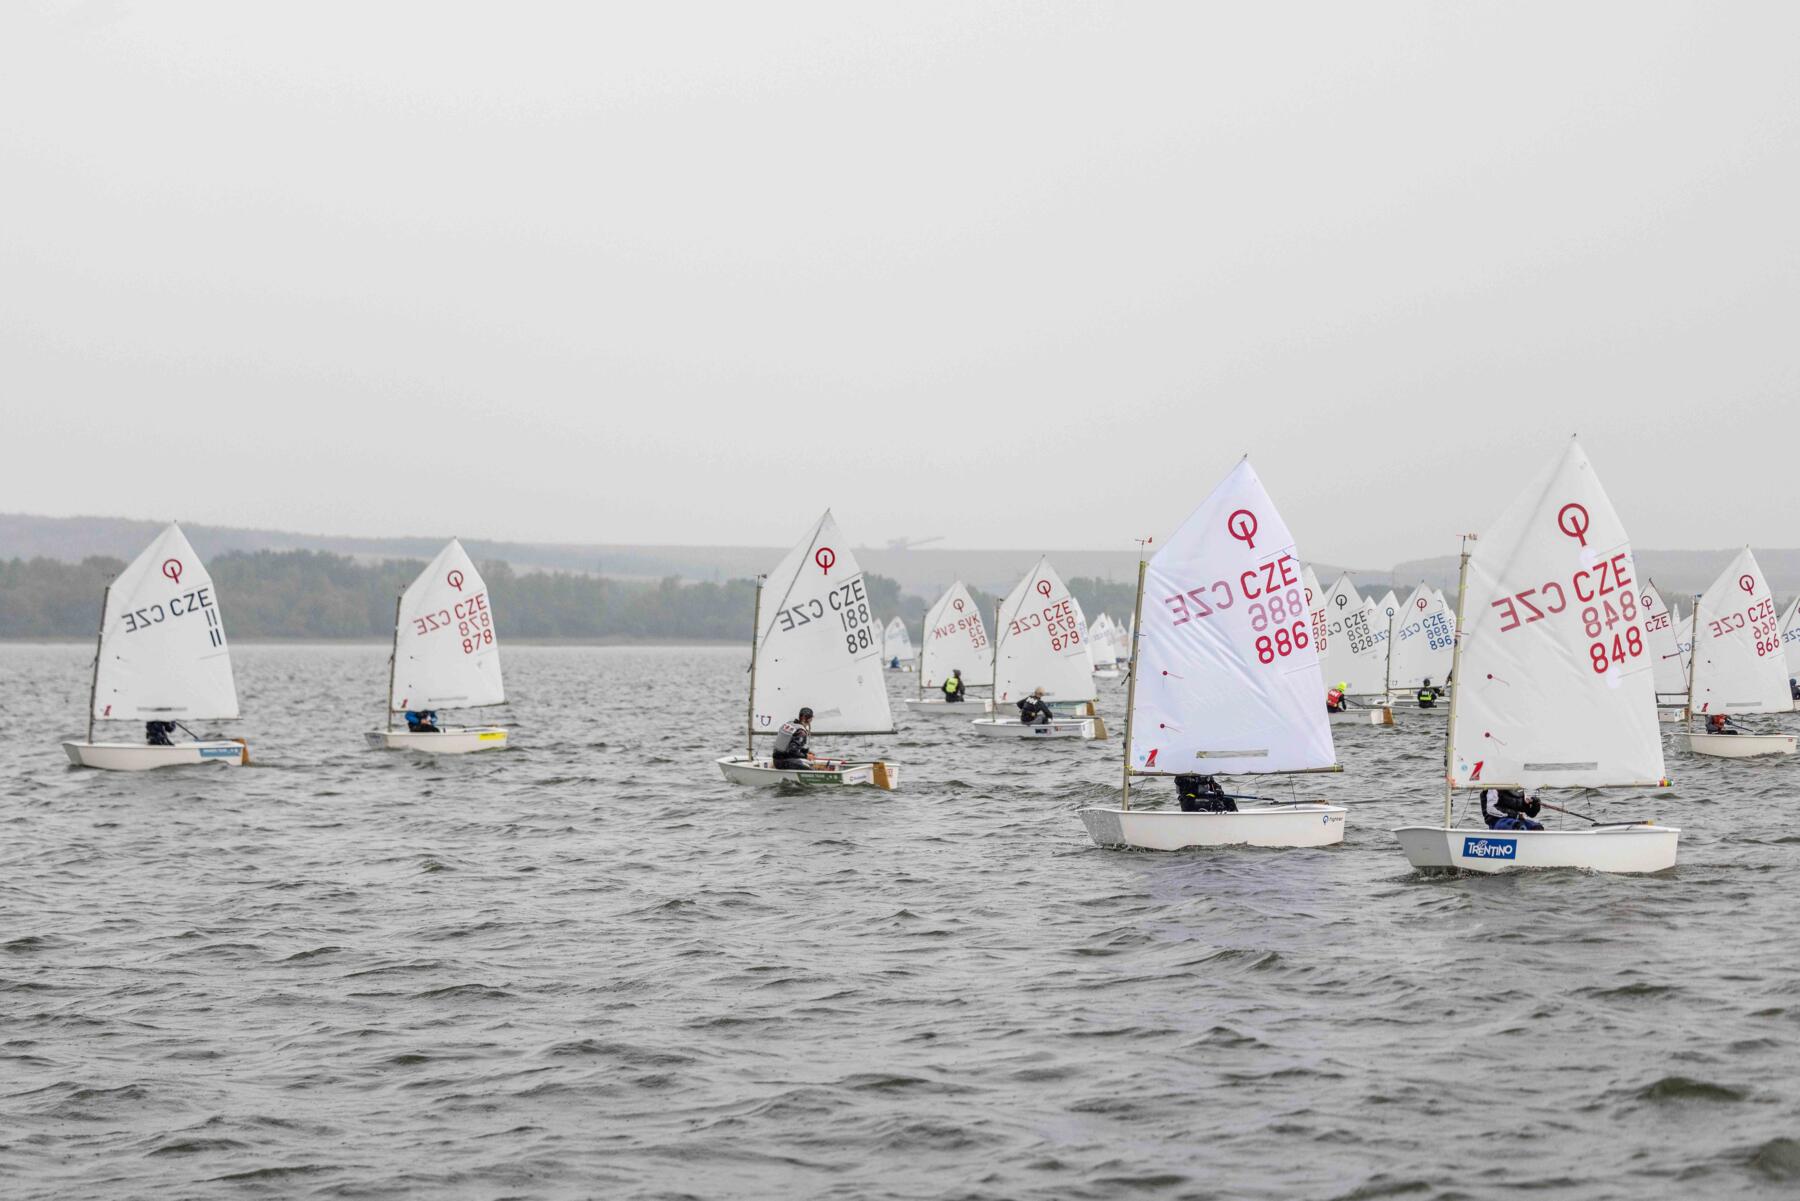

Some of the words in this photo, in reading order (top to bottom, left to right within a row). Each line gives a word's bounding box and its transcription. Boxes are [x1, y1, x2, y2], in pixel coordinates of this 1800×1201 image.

[1240, 555, 1298, 600] CZE
[1573, 553, 1632, 602] CZE
[170, 588, 213, 617] CZE
[829, 579, 865, 611] CZE
[454, 593, 487, 619] CZE
[1043, 600, 1072, 621] CZE
[1748, 599, 1773, 622] CZE
[958, 614, 981, 630] SVK
[1311, 609, 1326, 626] ZE
[1345, 611, 1366, 629] CZE
[1423, 613, 1446, 629] CZE
[1645, 615, 1669, 633] CZE
[209, 630, 222, 647] 11
[462, 629, 493, 654] 878
[846, 626, 873, 655] 881
[972, 636, 986, 648] 33
[1052, 631, 1079, 651] 879
[1255, 621, 1309, 664] 886
[1351, 636, 1373, 654] 828
[1430, 635, 1452, 650] 896
[1756, 634, 1779, 656] 866
[1590, 626, 1643, 673] 848
[1468, 842, 1512, 856] TRENTINO
